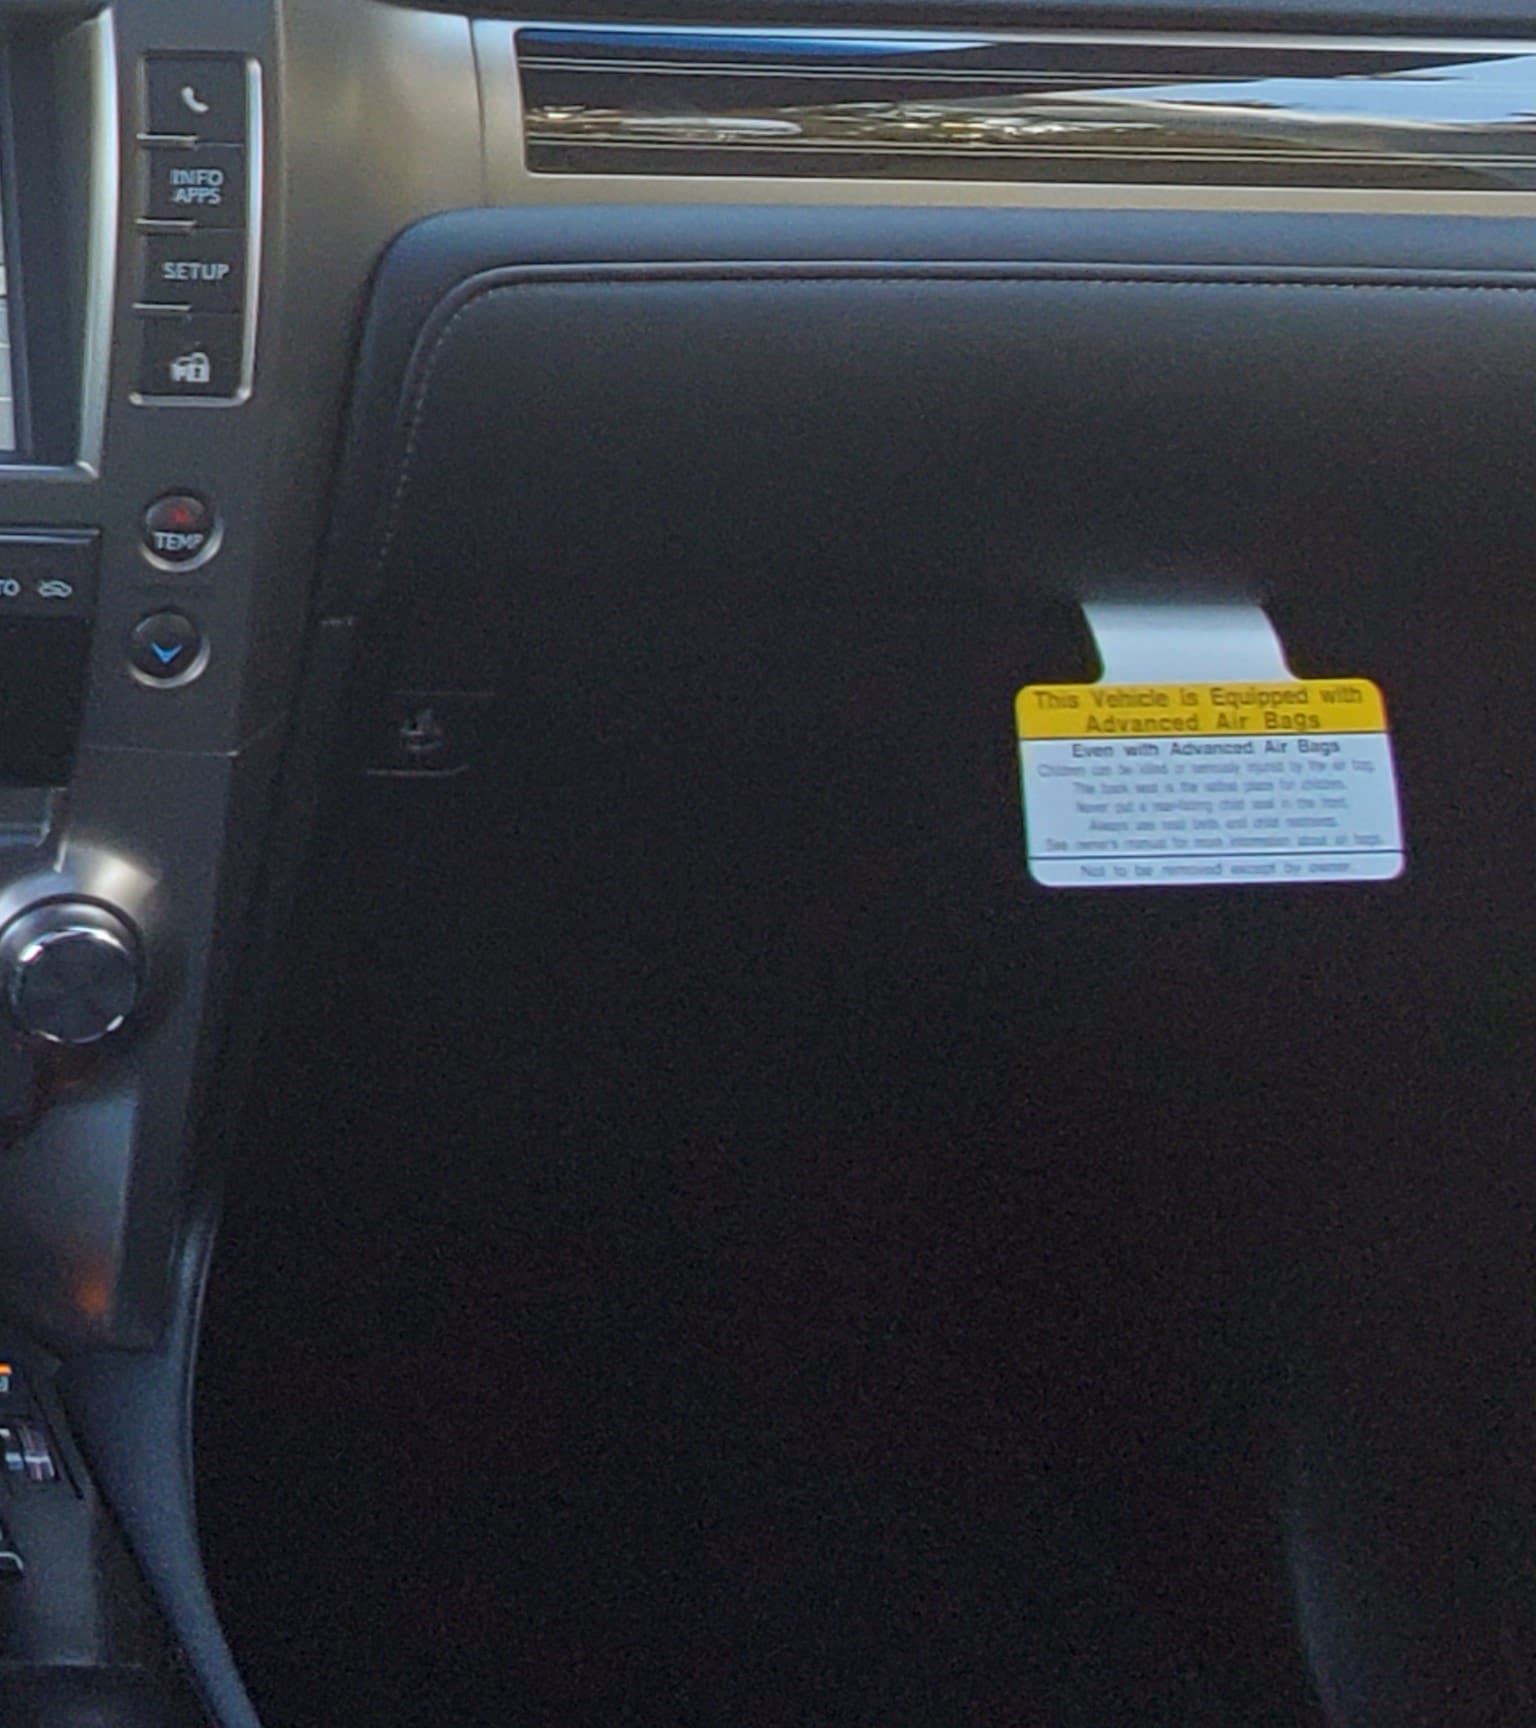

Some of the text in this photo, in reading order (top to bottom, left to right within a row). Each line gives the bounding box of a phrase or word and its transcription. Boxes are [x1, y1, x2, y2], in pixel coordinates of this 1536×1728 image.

[170, 168, 224, 186] INFO
[173, 187, 222, 205] APPS
[162, 261, 230, 280] SETUP
[153, 530, 204, 551] TEMP
[1035, 684, 1364, 710] This Vehicle is Equipped with
[1085, 710, 1323, 734] Advanced Air Bags
[1072, 738, 1341, 759] Even with Advanced Air Bags
